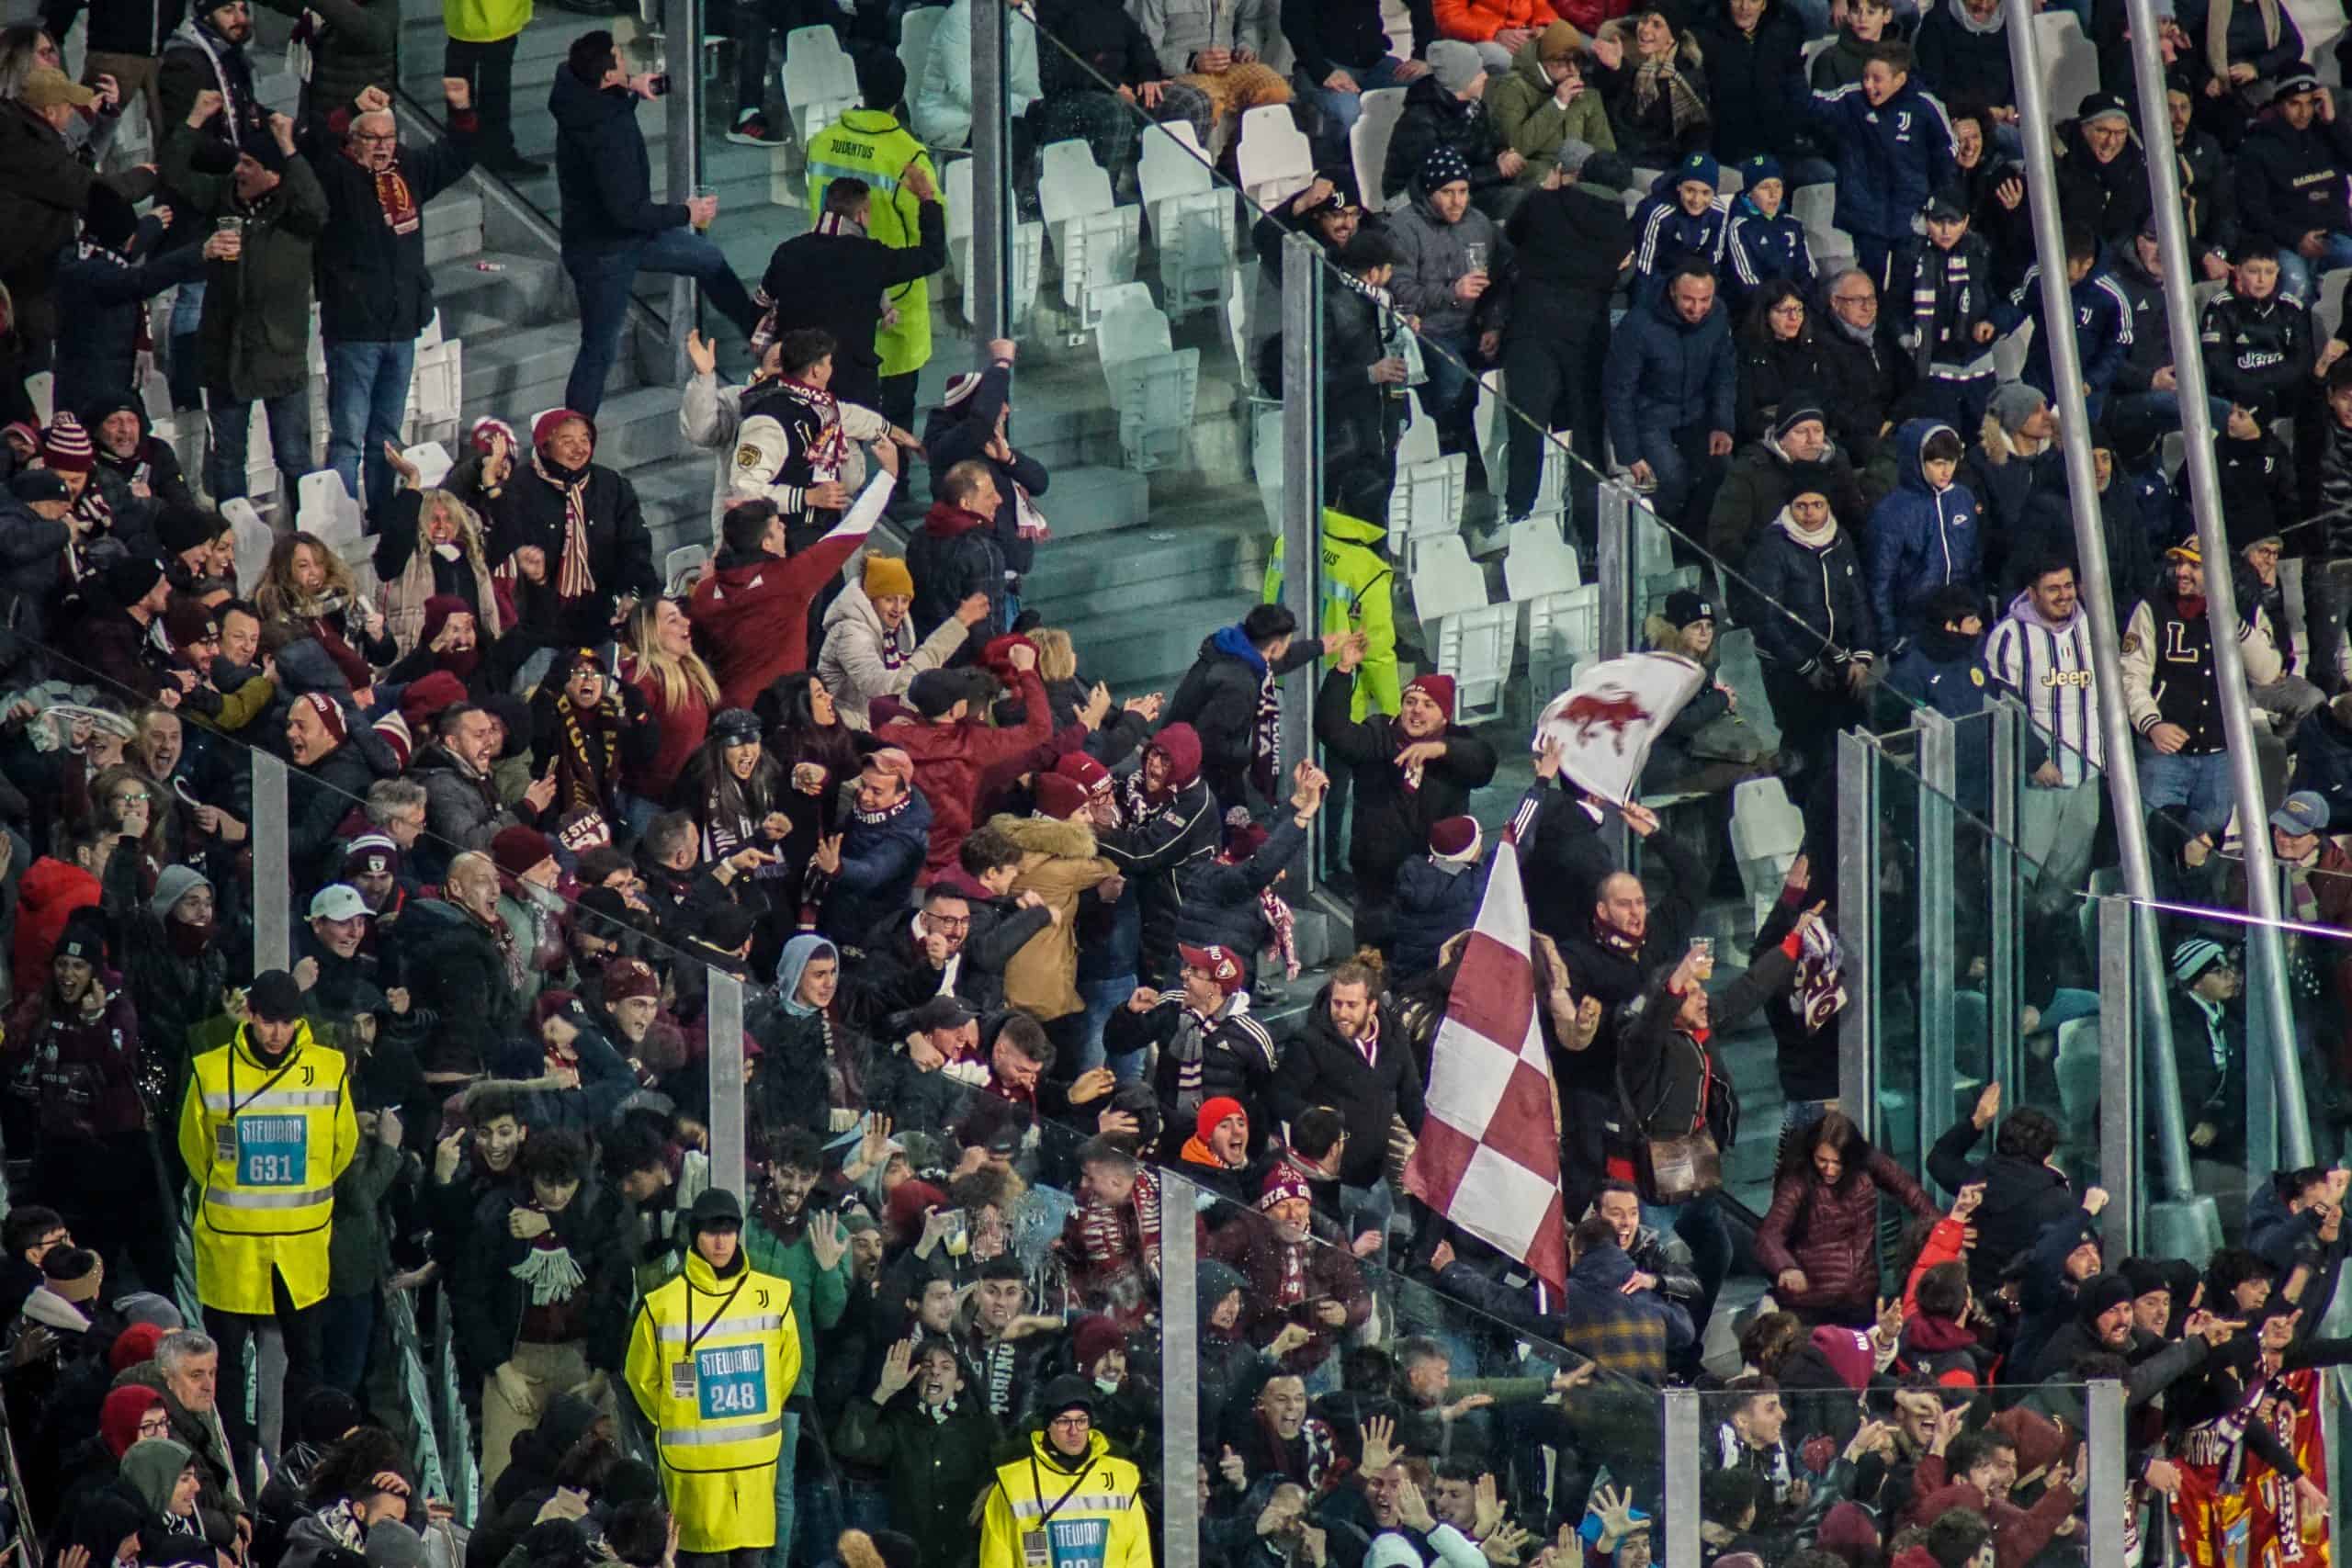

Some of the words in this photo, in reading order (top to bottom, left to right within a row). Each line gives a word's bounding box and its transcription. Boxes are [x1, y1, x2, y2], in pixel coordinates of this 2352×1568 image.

[830, 139, 876, 160] JUVENTUS
[2165, 621, 2199, 663] L
[2041, 666, 2093, 689] Jeep
[242, 1118, 302, 1144] STEWARD
[249, 1154, 293, 1183] 631
[700, 1348, 761, 1377] STEWARD
[989, 1342, 1015, 1415] TORINO
[710, 1382, 756, 1414] 248
